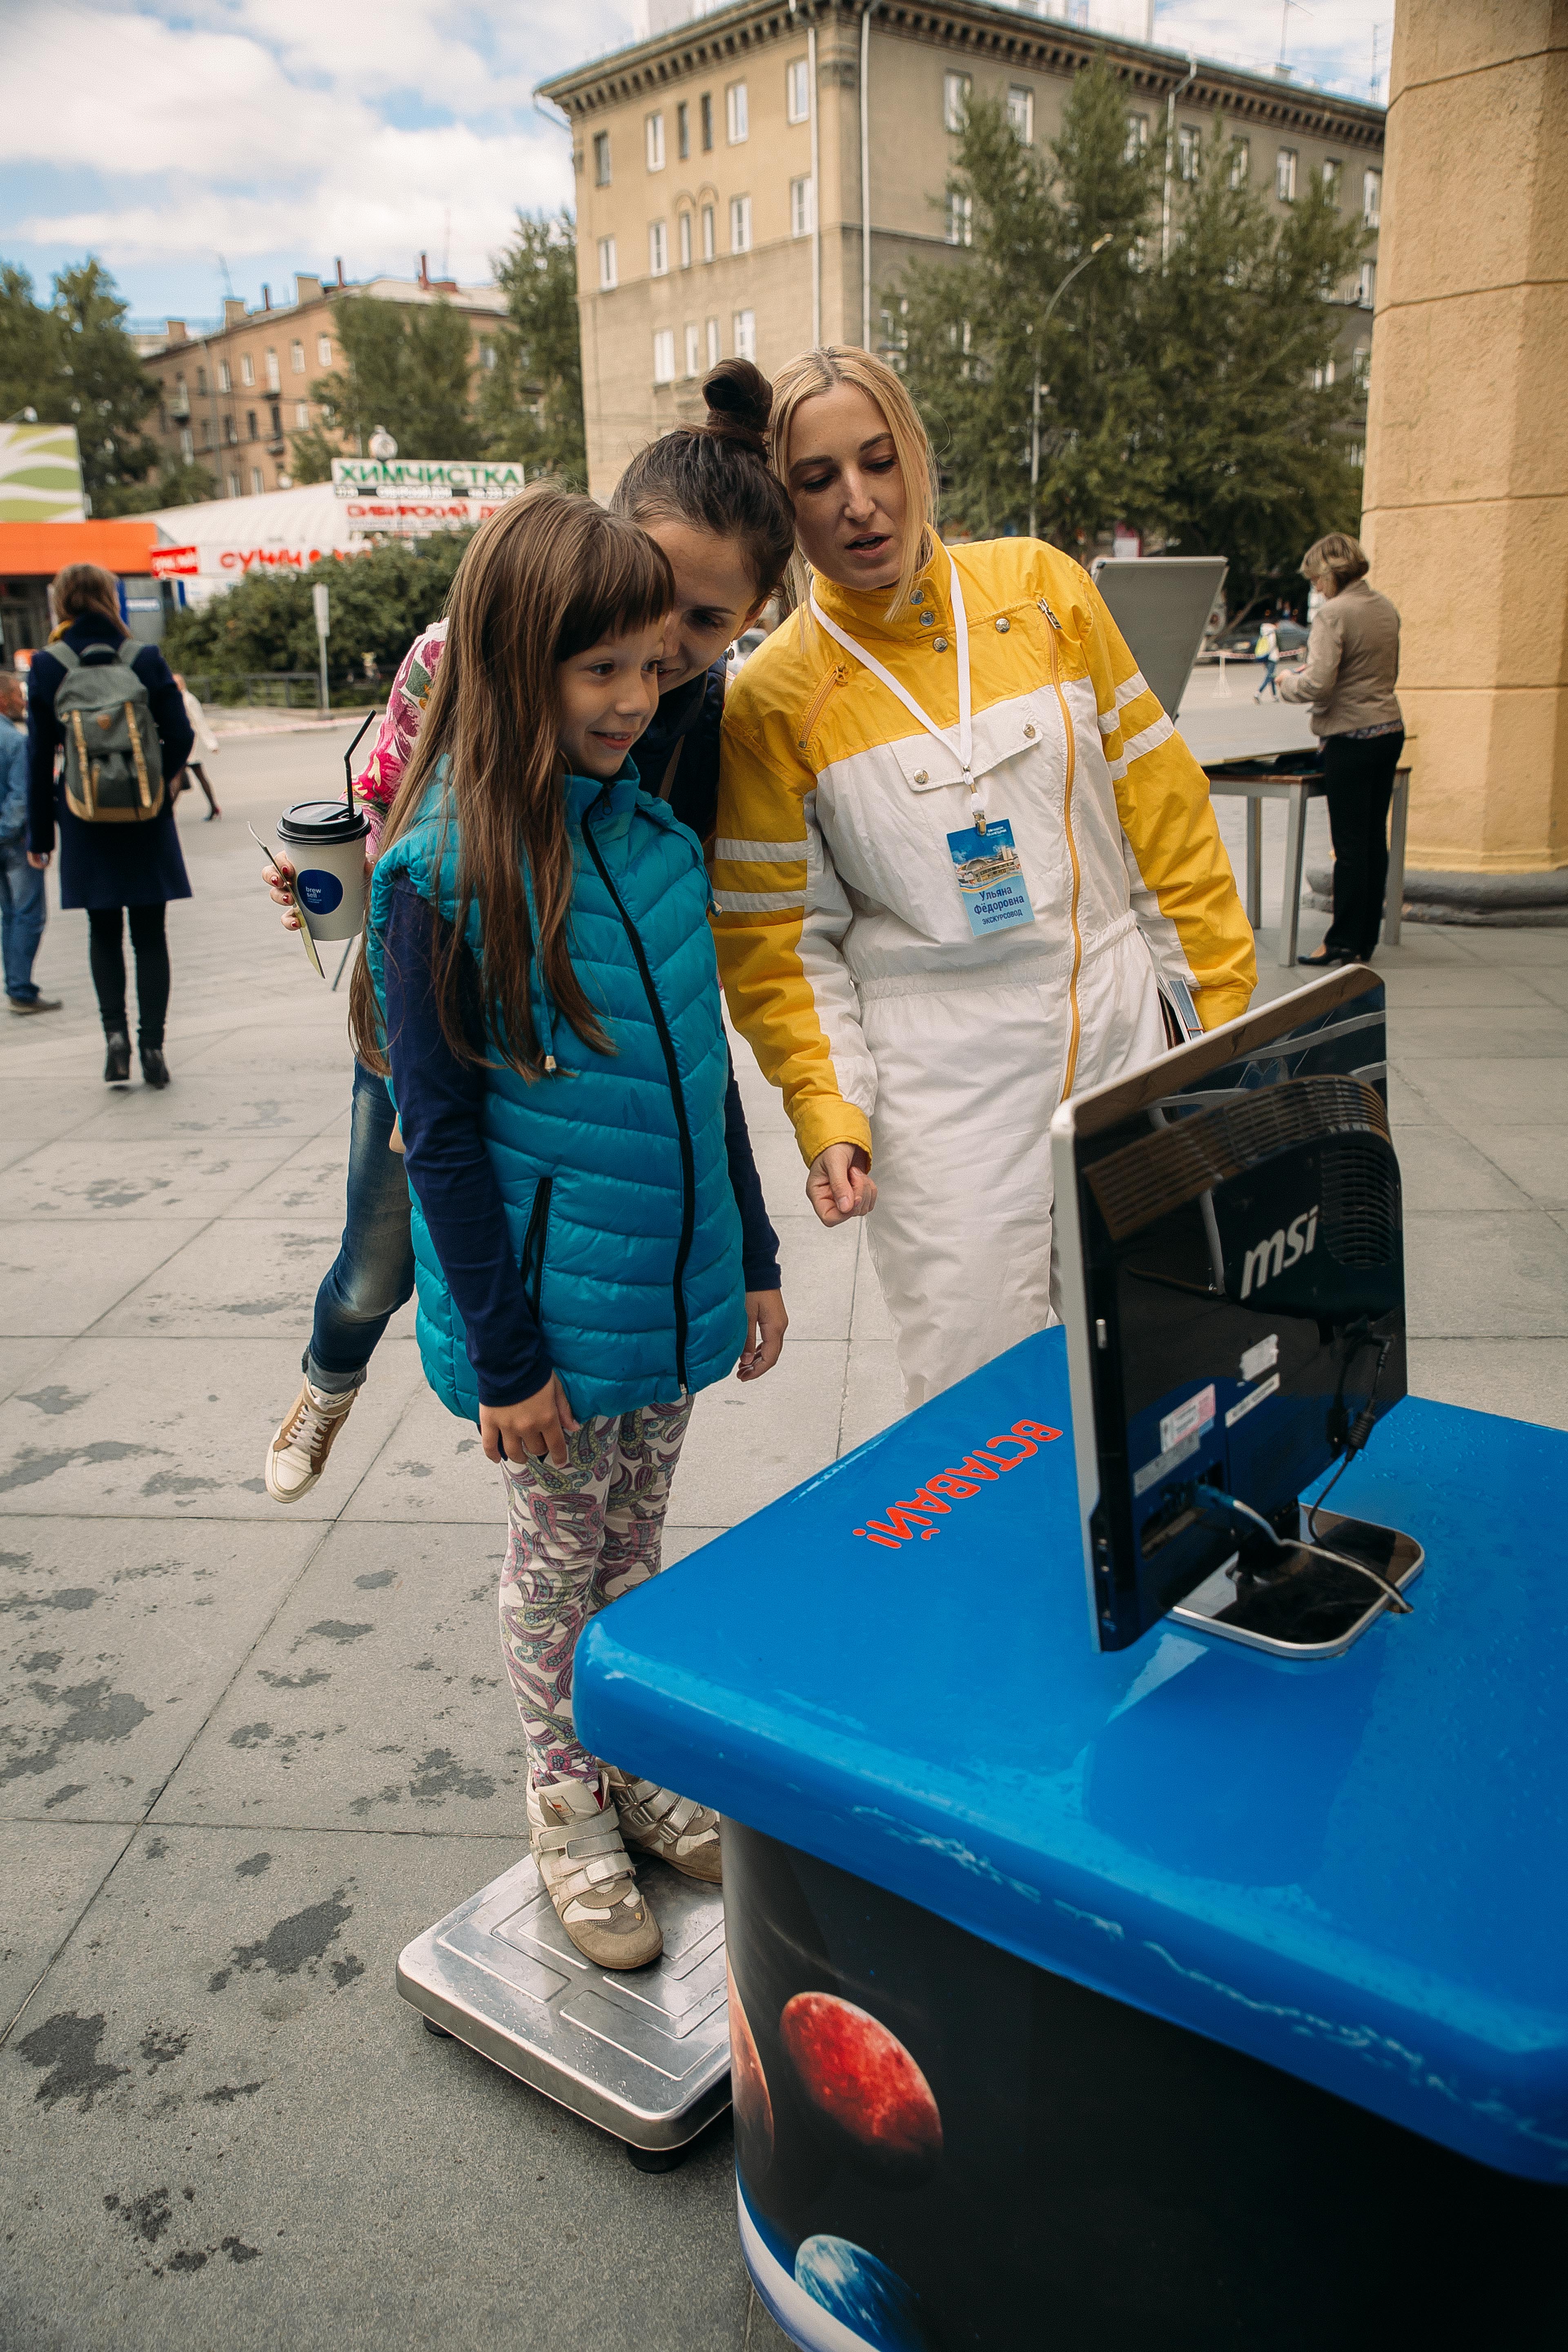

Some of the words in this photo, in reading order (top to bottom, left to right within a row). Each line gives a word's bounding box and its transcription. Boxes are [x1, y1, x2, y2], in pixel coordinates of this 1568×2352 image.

[340, 464, 518, 484] ХИМЧИСТКА
[979, 886, 1012, 901] Ульяна
[974, 895, 1025, 915] Фёдоровна
[982, 909, 1023, 924] ЭКСКУРСОВОД
[1240, 1205, 1319, 1300] msi
[853, 1419, 1063, 1549] ВСТАВАЙ!
